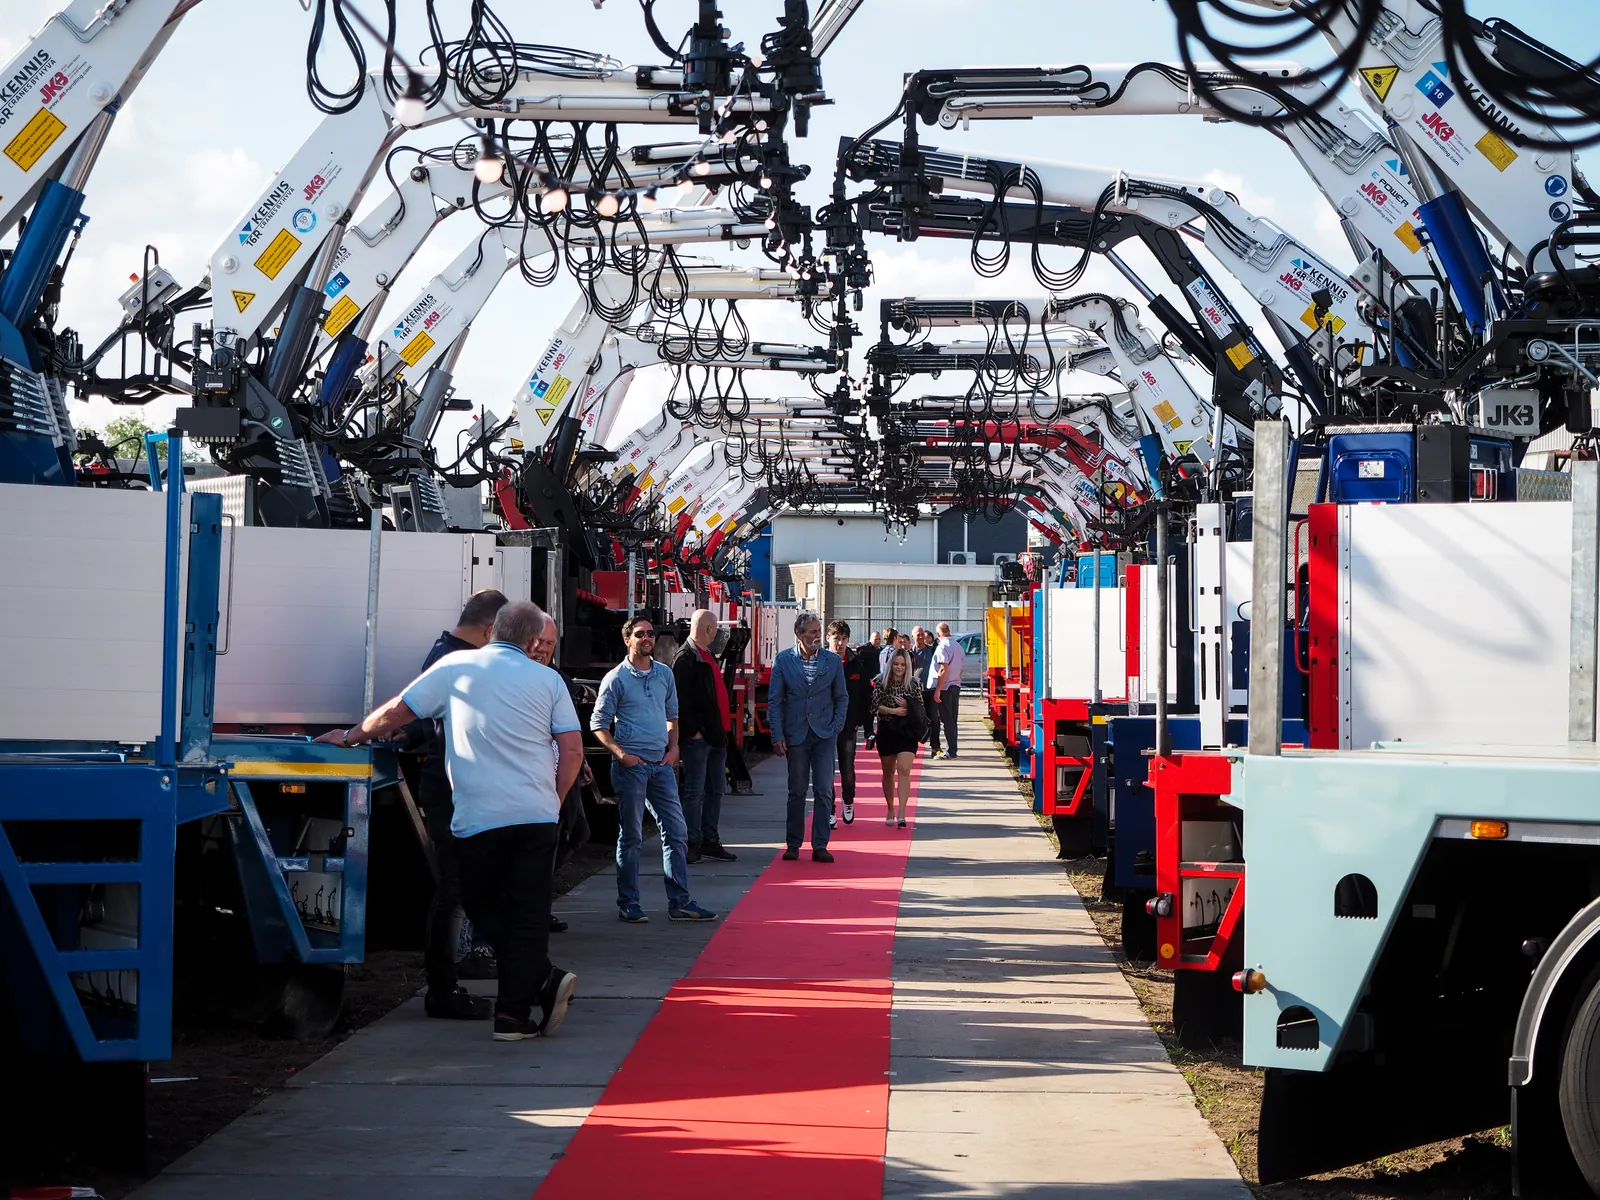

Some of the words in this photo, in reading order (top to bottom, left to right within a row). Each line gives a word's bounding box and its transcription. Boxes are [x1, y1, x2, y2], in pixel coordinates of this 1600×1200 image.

[0, 49, 50, 103] KENNIS
[8, 83, 33, 109] CRANES
[31, 75, 40, 86] BY
[40, 59, 56, 77] HYVA
[1425, 80, 1434, 90] R
[1434, 88, 1444, 99] 16
[251, 180, 289, 225] KENNIS
[1379, 178, 1409, 207] POWER
[246, 230, 263, 247] 16R
[1292, 268, 1307, 281] 14R
[1310, 268, 1348, 299] KENNIS
[404, 293, 434, 324] KENNIS
[1207, 290, 1228, 316] KENNIS
[399, 326, 412, 340] 14R
[537, 338, 563, 373] KENNIS
[1487, 405, 1534, 426] JKB
